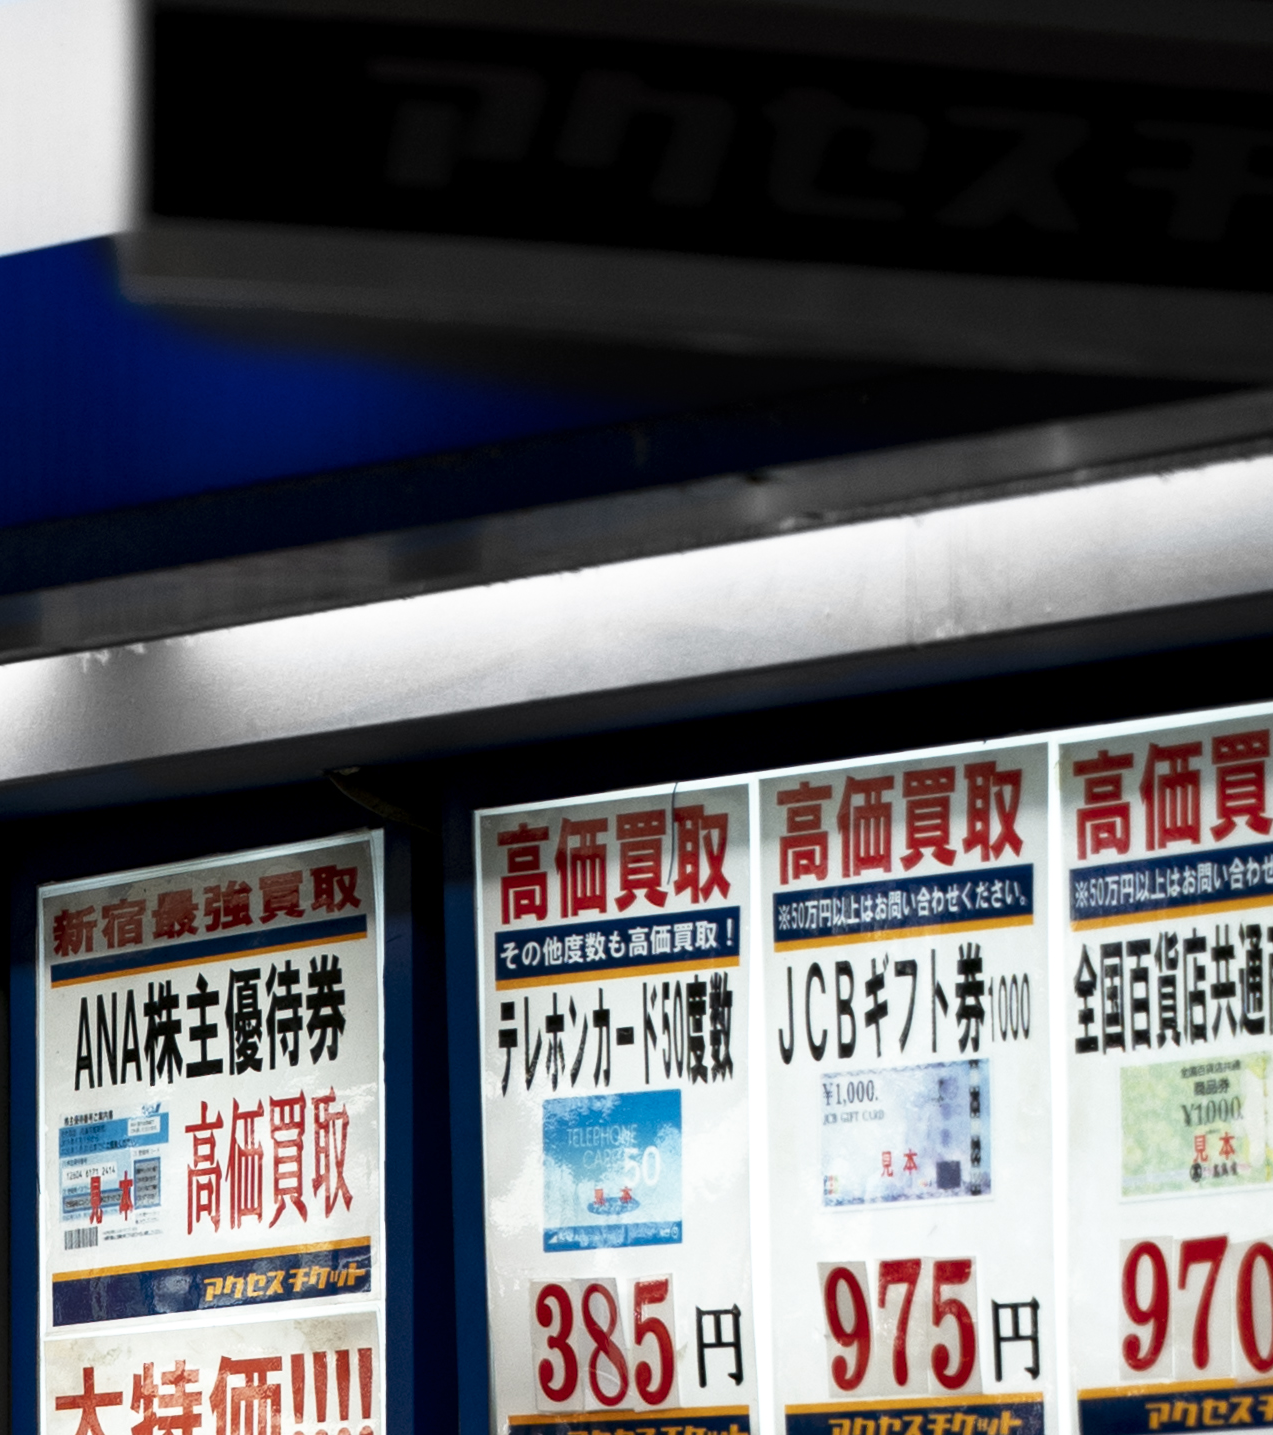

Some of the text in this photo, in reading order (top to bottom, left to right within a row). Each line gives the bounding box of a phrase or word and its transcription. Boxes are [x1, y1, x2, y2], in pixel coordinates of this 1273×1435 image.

[496, 804, 733, 925] 高価買取
[776, 762, 1024, 885] 高価買取
[52, 863, 362, 958] 新宿最強買取
[74, 954, 347, 1091] ANA株主優待券
[498, 971, 734, 1096] テレホンカード50度数
[778, 941, 1032, 1066] JCBギフト券1000
[183, 1086, 355, 1237] 高価買取
[204, 1267, 366, 1302] アクセスチケット
